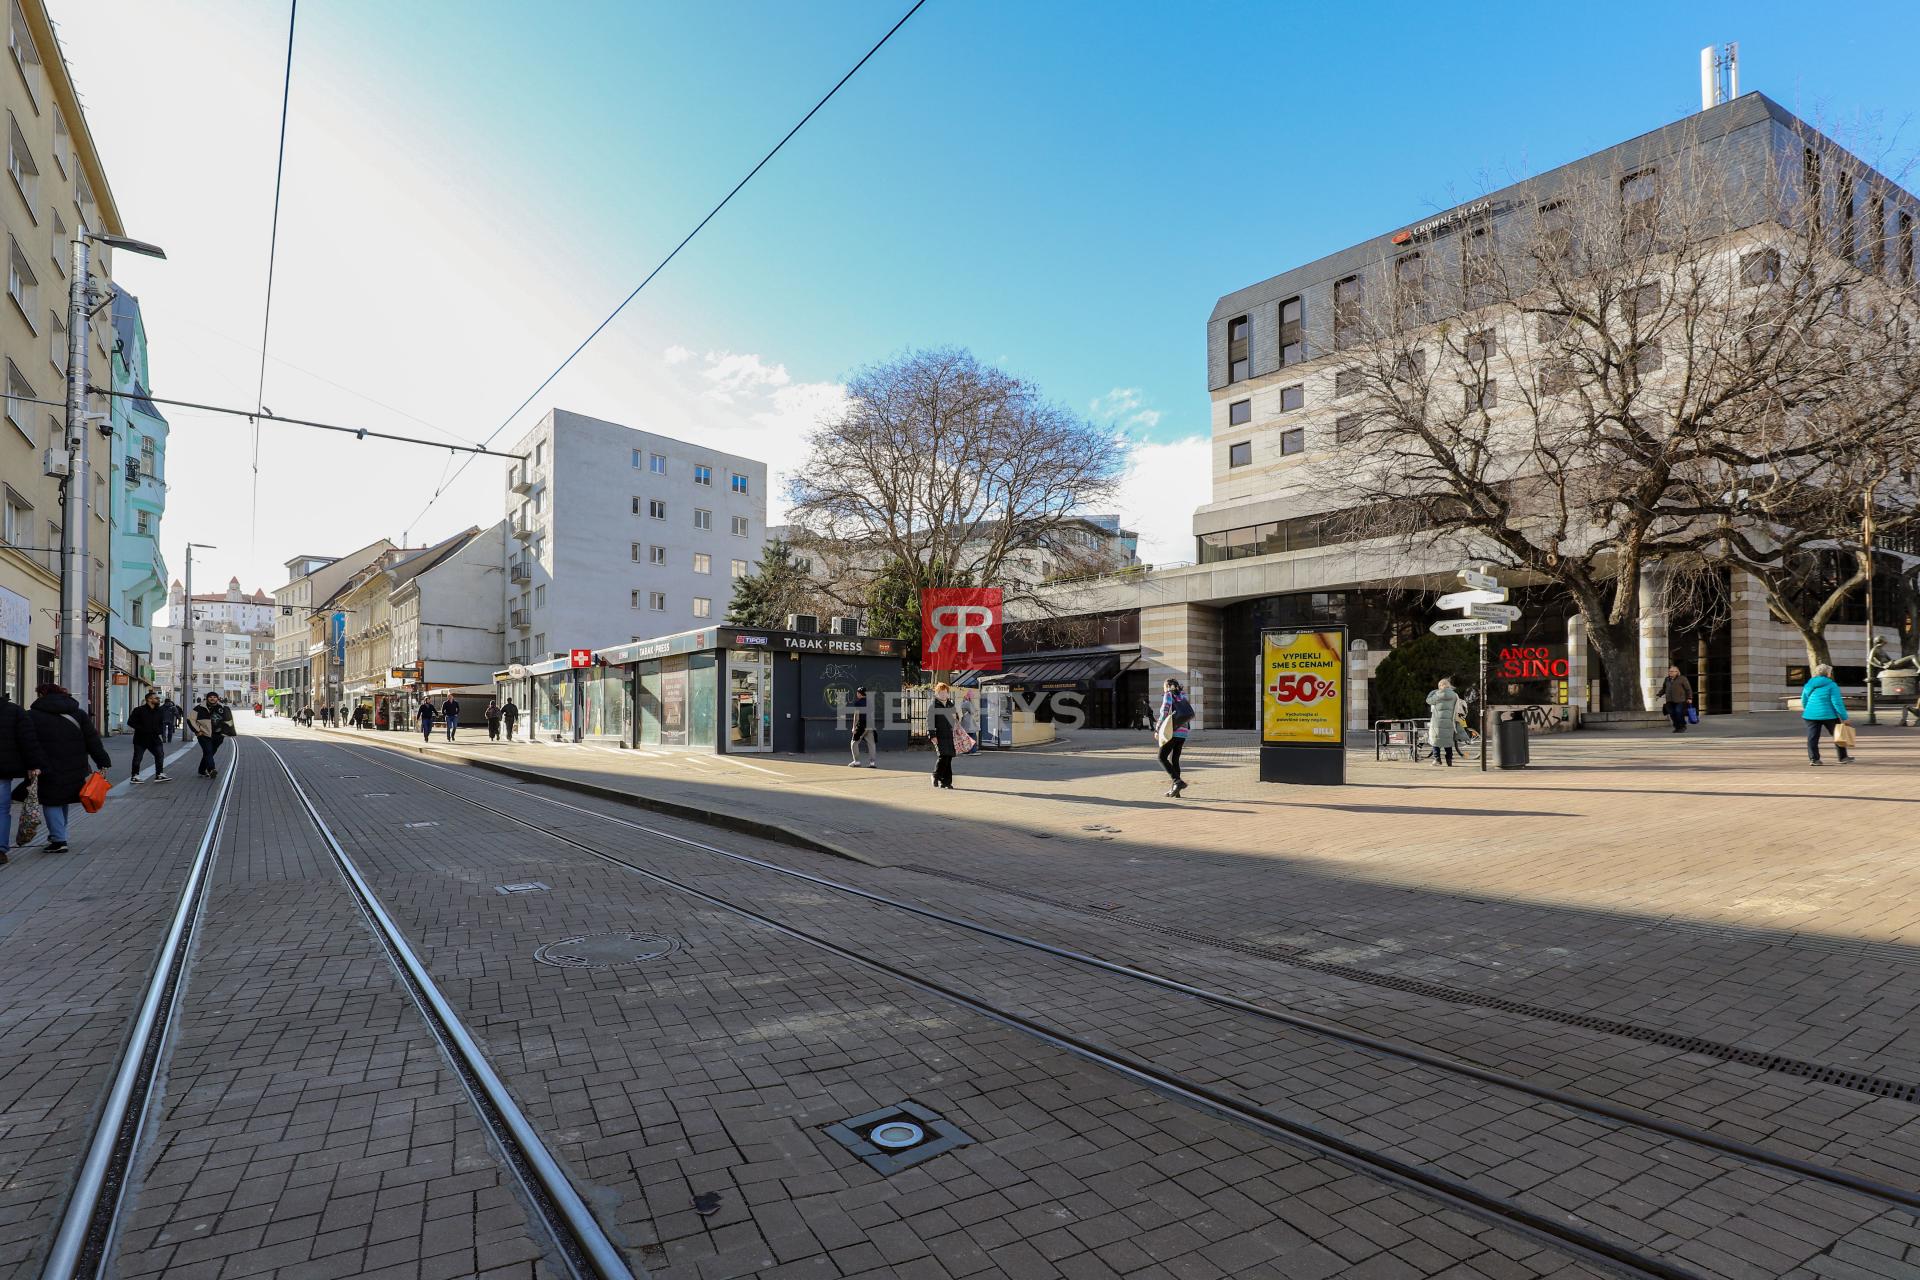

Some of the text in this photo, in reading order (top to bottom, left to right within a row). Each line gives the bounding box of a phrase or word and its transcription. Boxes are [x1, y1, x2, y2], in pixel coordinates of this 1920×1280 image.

[1413, 201, 1490, 235] CROWNE PLAZA
[654, 642, 670, 655] PRESS
[784, 638, 862, 651] TABAK PRESS
[1269, 674, 1336, 702] -50%
